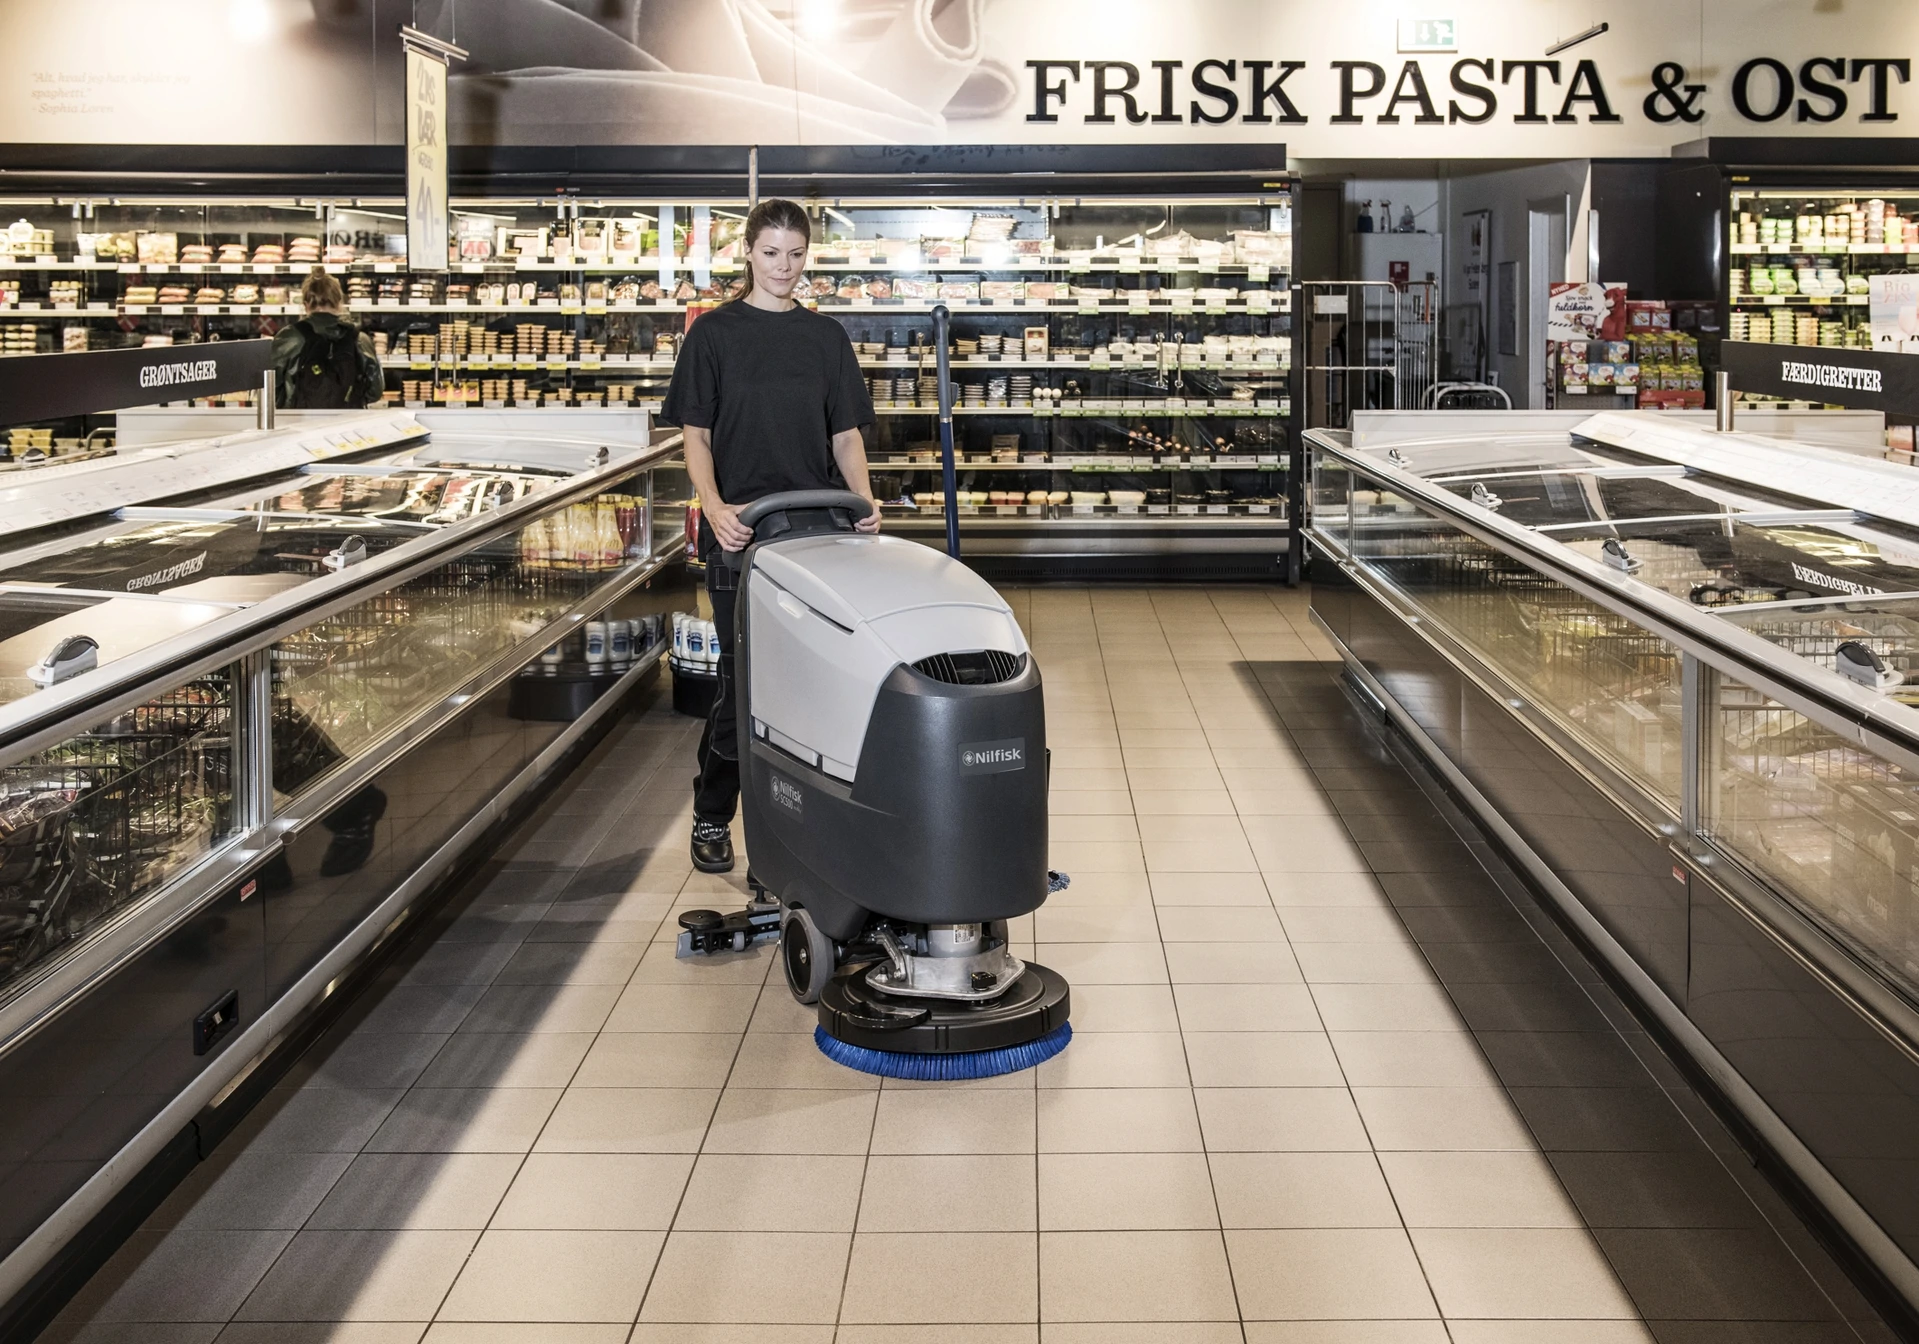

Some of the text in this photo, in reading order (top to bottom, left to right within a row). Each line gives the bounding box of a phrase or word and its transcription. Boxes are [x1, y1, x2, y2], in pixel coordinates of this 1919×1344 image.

[1025, 57, 1911, 124] FRISK PASTA & OST
[140, 360, 217, 388] GRØNTSAGER
[1781, 361, 1882, 393] FÆRDIGRETTER
[975, 748, 1022, 764] Nilfisk
[780, 780, 802, 805] Nilfisk
